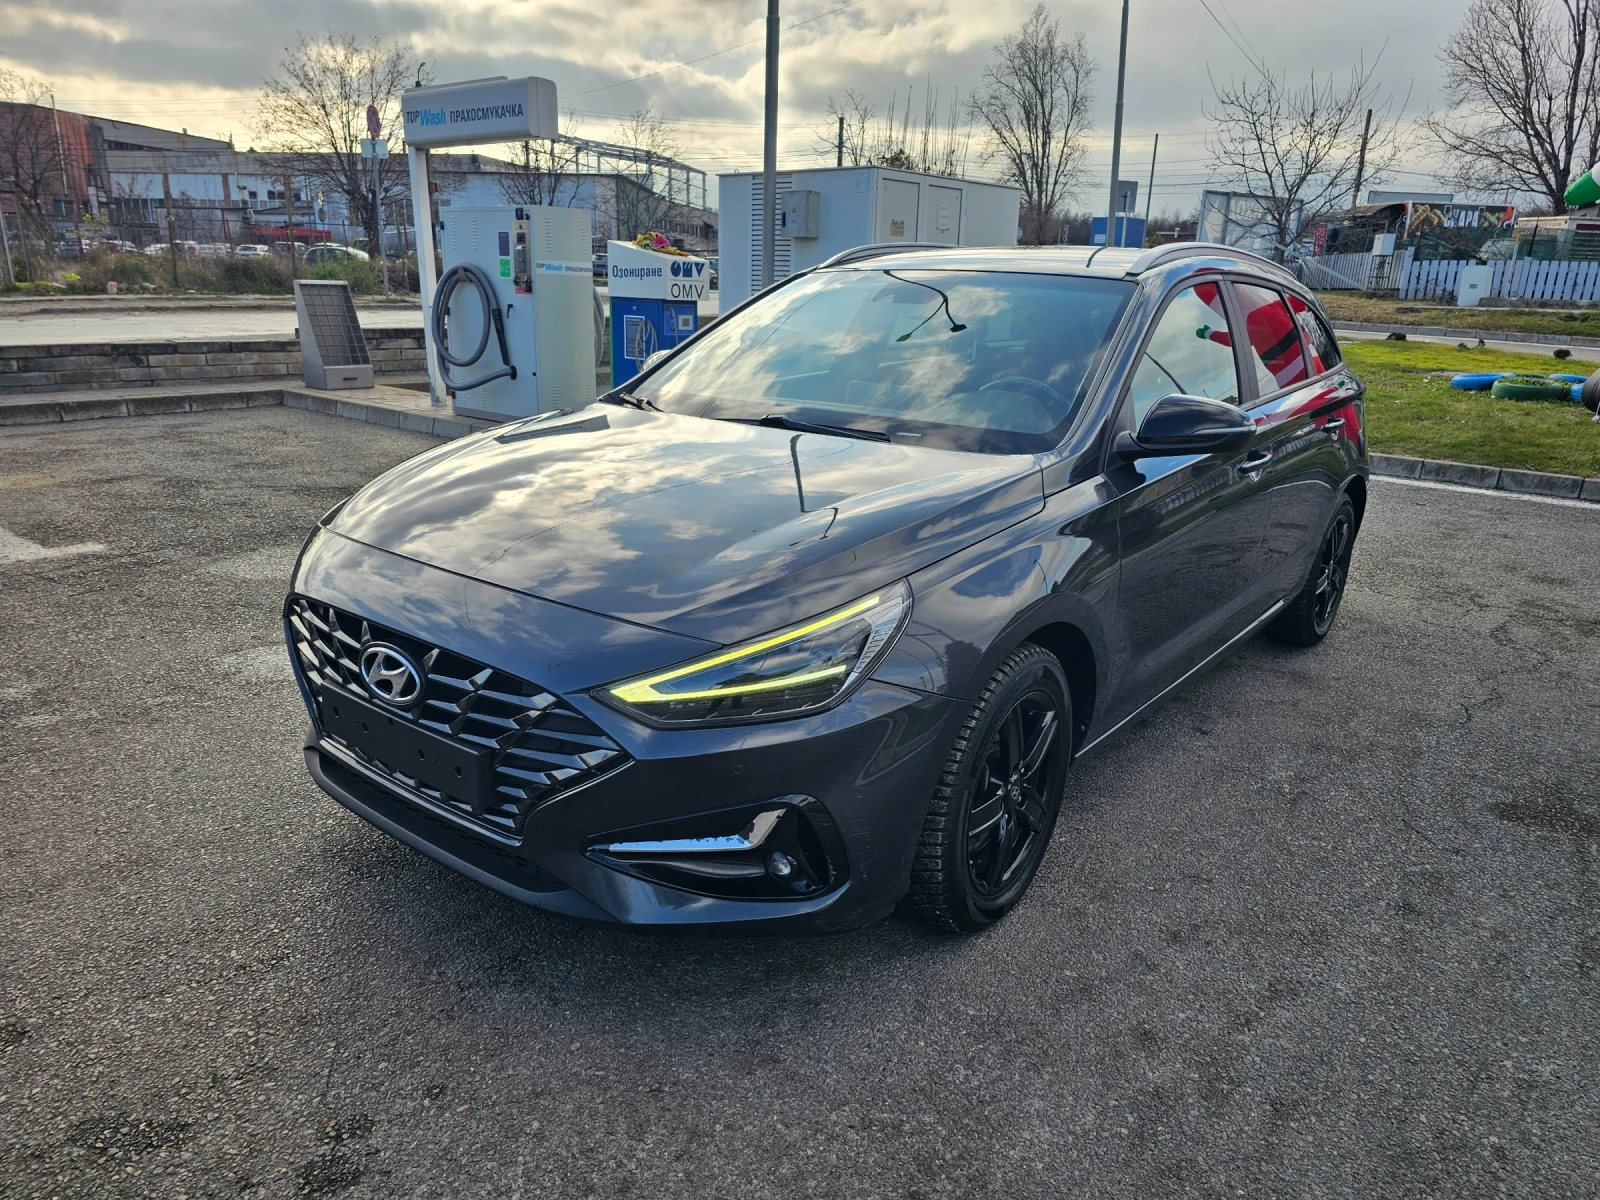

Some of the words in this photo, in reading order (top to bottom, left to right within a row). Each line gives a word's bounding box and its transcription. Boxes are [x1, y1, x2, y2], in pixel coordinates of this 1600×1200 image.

[450, 103, 524, 123] ПРАХОСМУКАЧКА
[612, 264, 662, 281] Озониране
[670, 283, 704, 299] OMV
